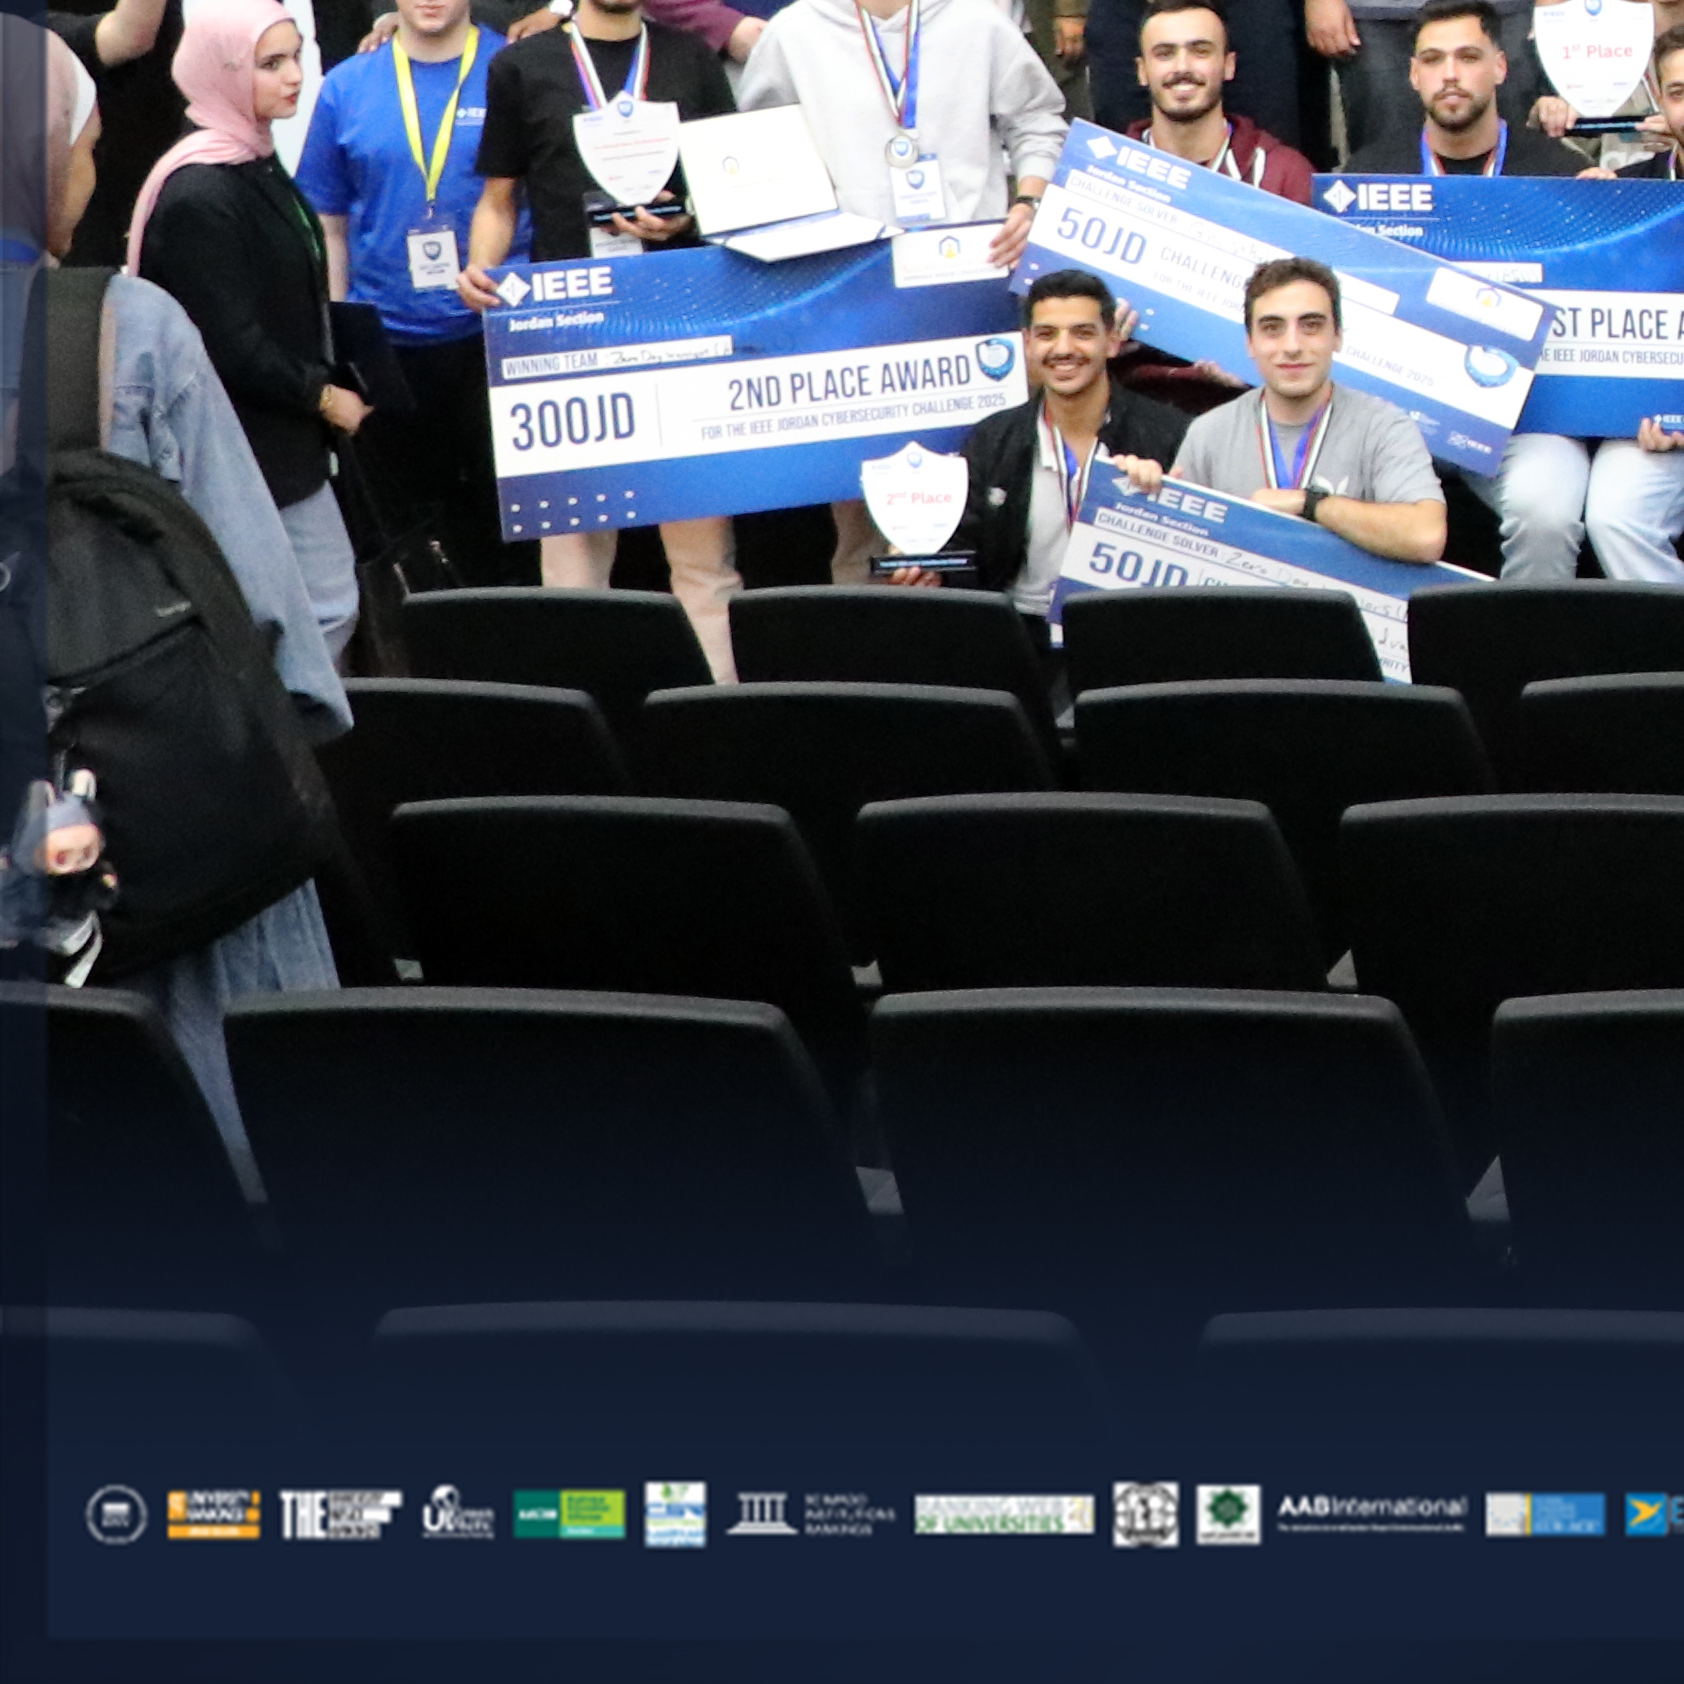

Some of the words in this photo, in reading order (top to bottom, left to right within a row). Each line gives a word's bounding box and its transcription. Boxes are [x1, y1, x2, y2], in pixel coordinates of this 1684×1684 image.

[1562, 43, 1582, 59] 1st
[1586, 42, 1634, 59] Place
[1115, 145, 1193, 191] IEEE
[1069, 173, 1134, 215] CHALLENGE
[1137, 199, 1179, 227] SOLVER
[1357, 182, 1433, 212] IEEE
[1057, 206, 1148, 266] 50JD
[531, 266, 614, 302] IEEE
[509, 314, 554, 332] Jordan
[556, 311, 605, 328] Section
[1551, 308, 1581, 340] ST
[1591, 308, 1669, 341] PLACE
[505, 357, 561, 377] WINNING
[563, 352, 599, 370] TEAM
[1553, 347, 1576, 363] IEEE
[1579, 348, 1620, 364] JORDAN
[510, 391, 637, 452] 300JD
[728, 375, 782, 411] 2ND
[789, 365, 873, 404] PLACE
[880, 354, 972, 394] AWARD
[700, 426, 723, 441] FOR
[725, 423, 748, 438] THE
[750, 421, 774, 436] IEEE
[777, 416, 819, 434] JORDAN
[820, 406, 908, 427] CYBERSECURITY
[911, 398, 975, 417] CHALLENGE
[977, 392, 1006, 409] 2025
[910, 491, 953, 505] Place
[1145, 486, 1229, 524] IEEE
[1097, 510, 1170, 546] CHALLENGE
[1172, 534, 1219, 558] SOLVER
[1115, 502, 1158, 523] Jordan
[1159, 514, 1209, 536] Section
[1089, 541, 1189, 587] 50JD
